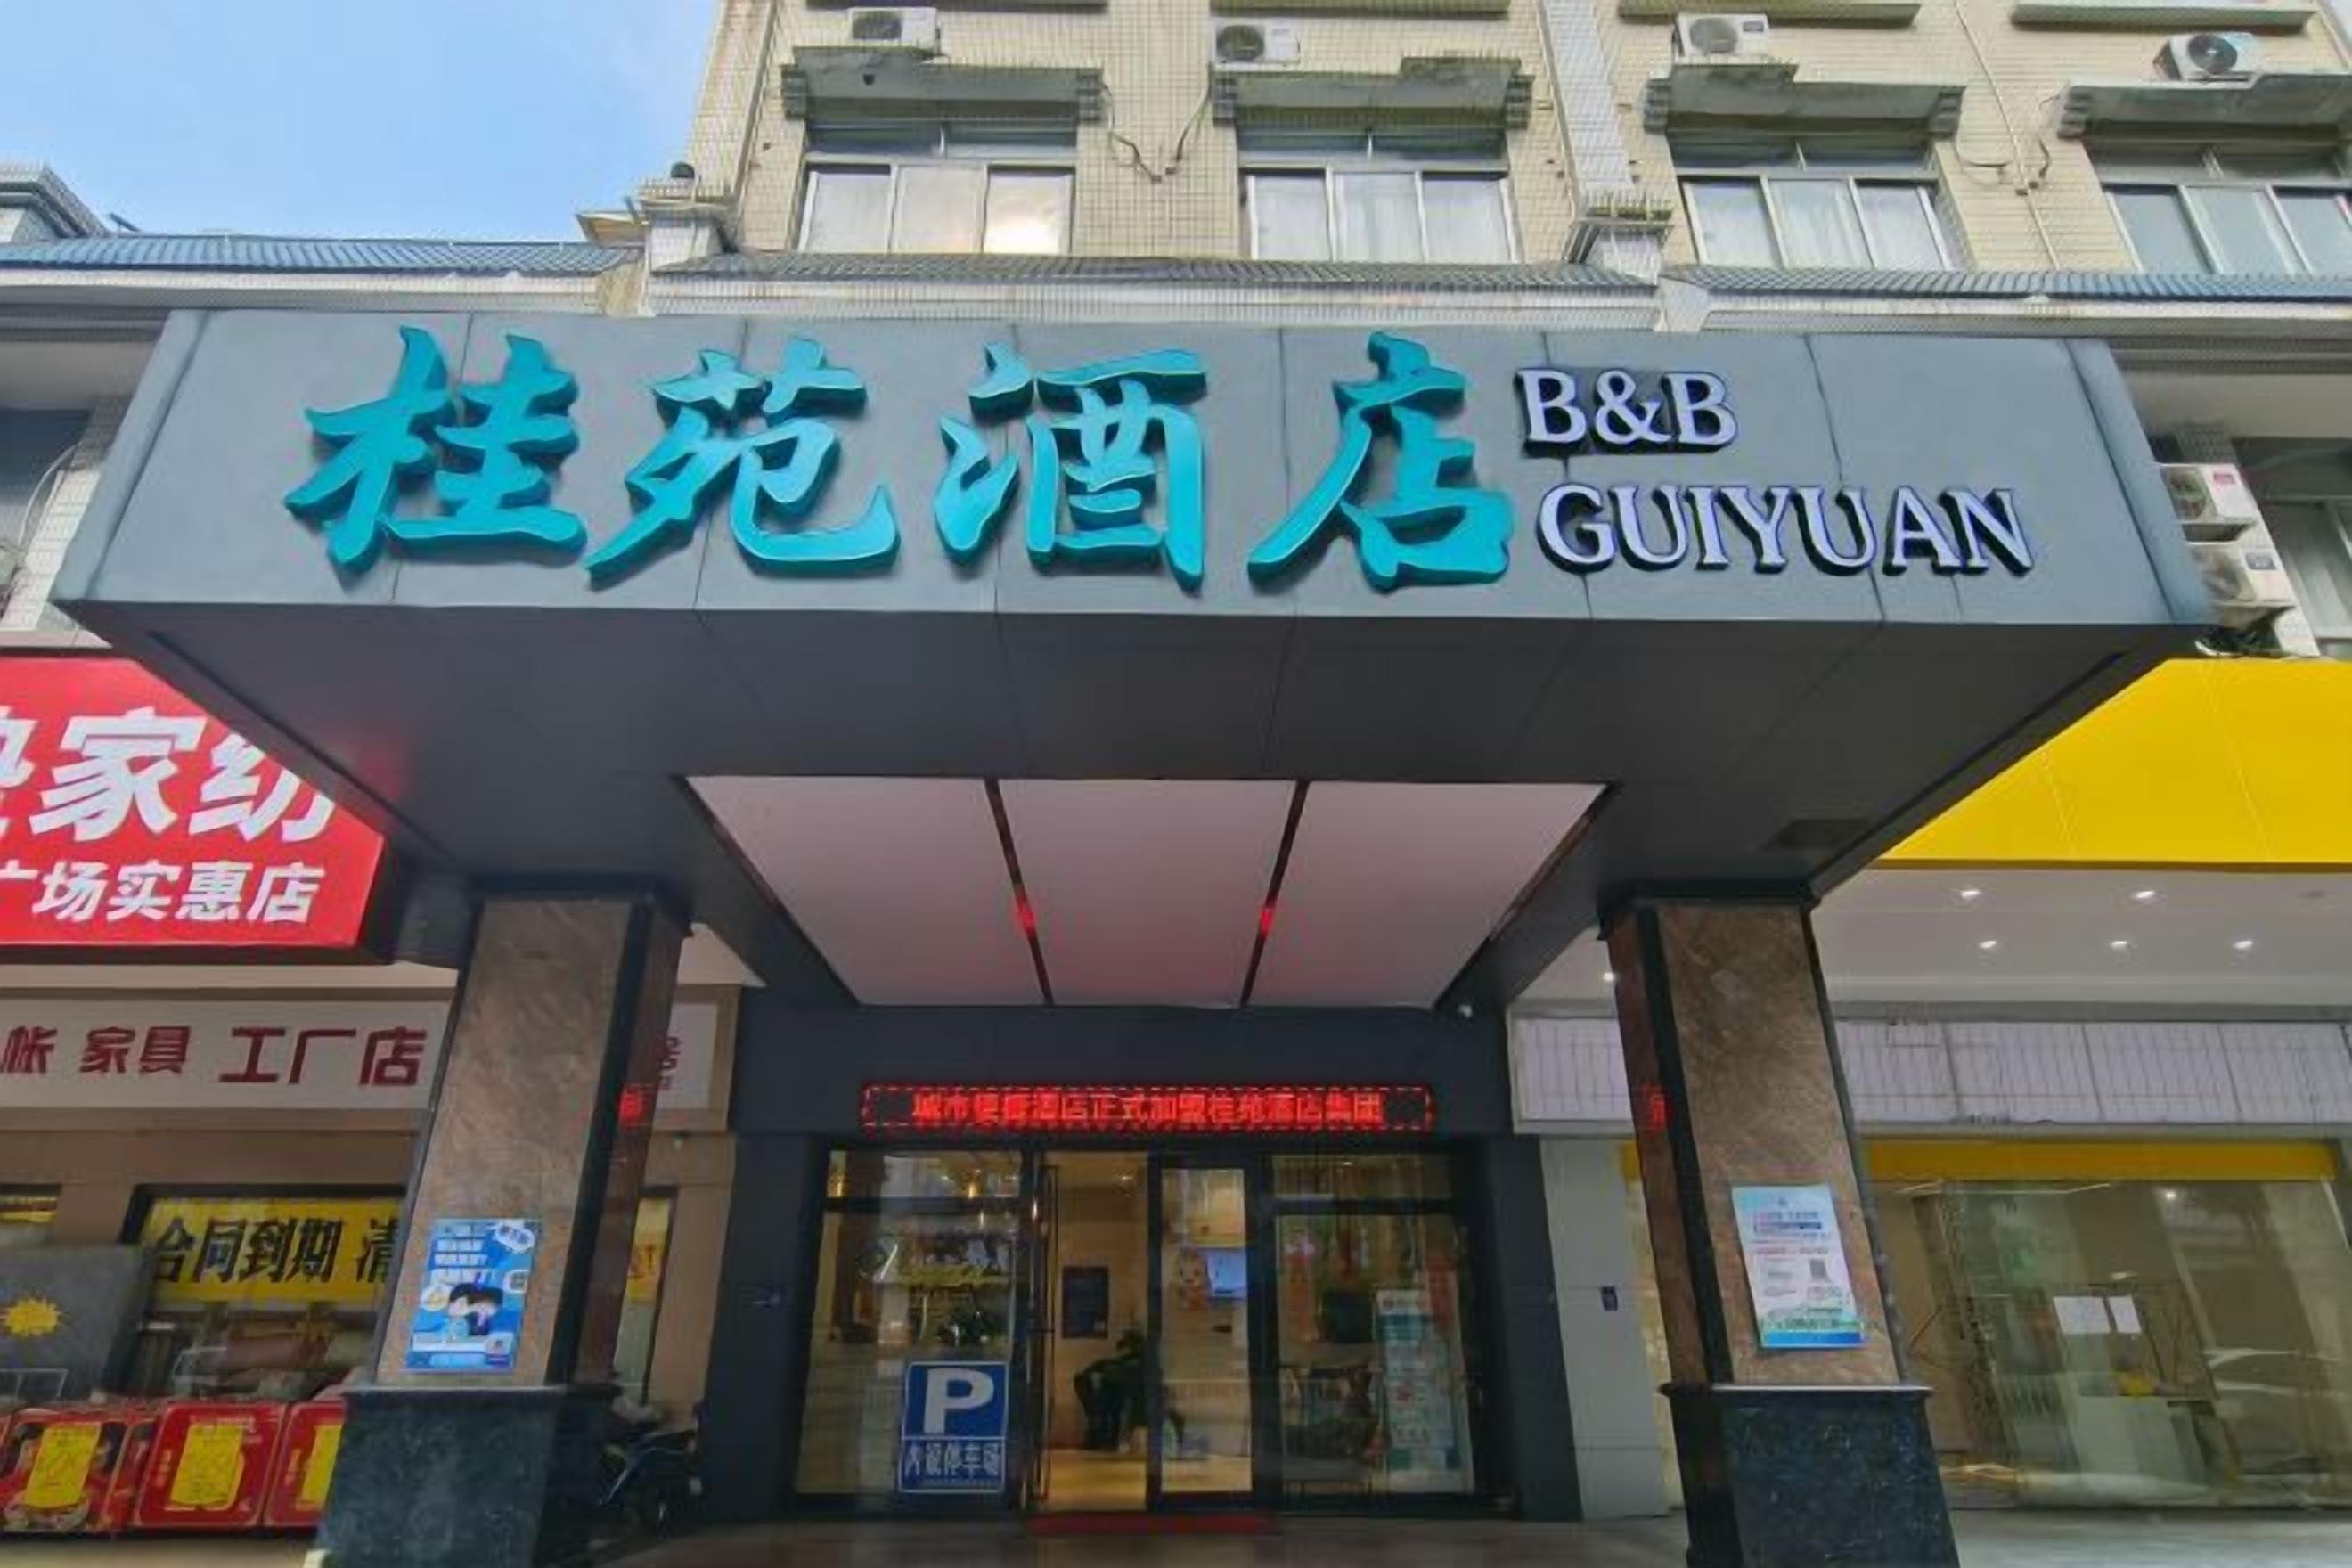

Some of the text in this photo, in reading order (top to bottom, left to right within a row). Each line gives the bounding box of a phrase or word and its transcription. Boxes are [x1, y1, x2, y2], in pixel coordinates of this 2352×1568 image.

[1515, 368, 1738, 453] B&B
[285, 324, 1513, 597] 桂苑酒店
[1536, 482, 2035, 577] GUIYUAN
[78, 1025, 192, 1074] 家具
[218, 1026, 428, 1086] 工厂店
[154, 1218, 344, 1284] 合同到期
[923, 1367, 995, 1434] P
